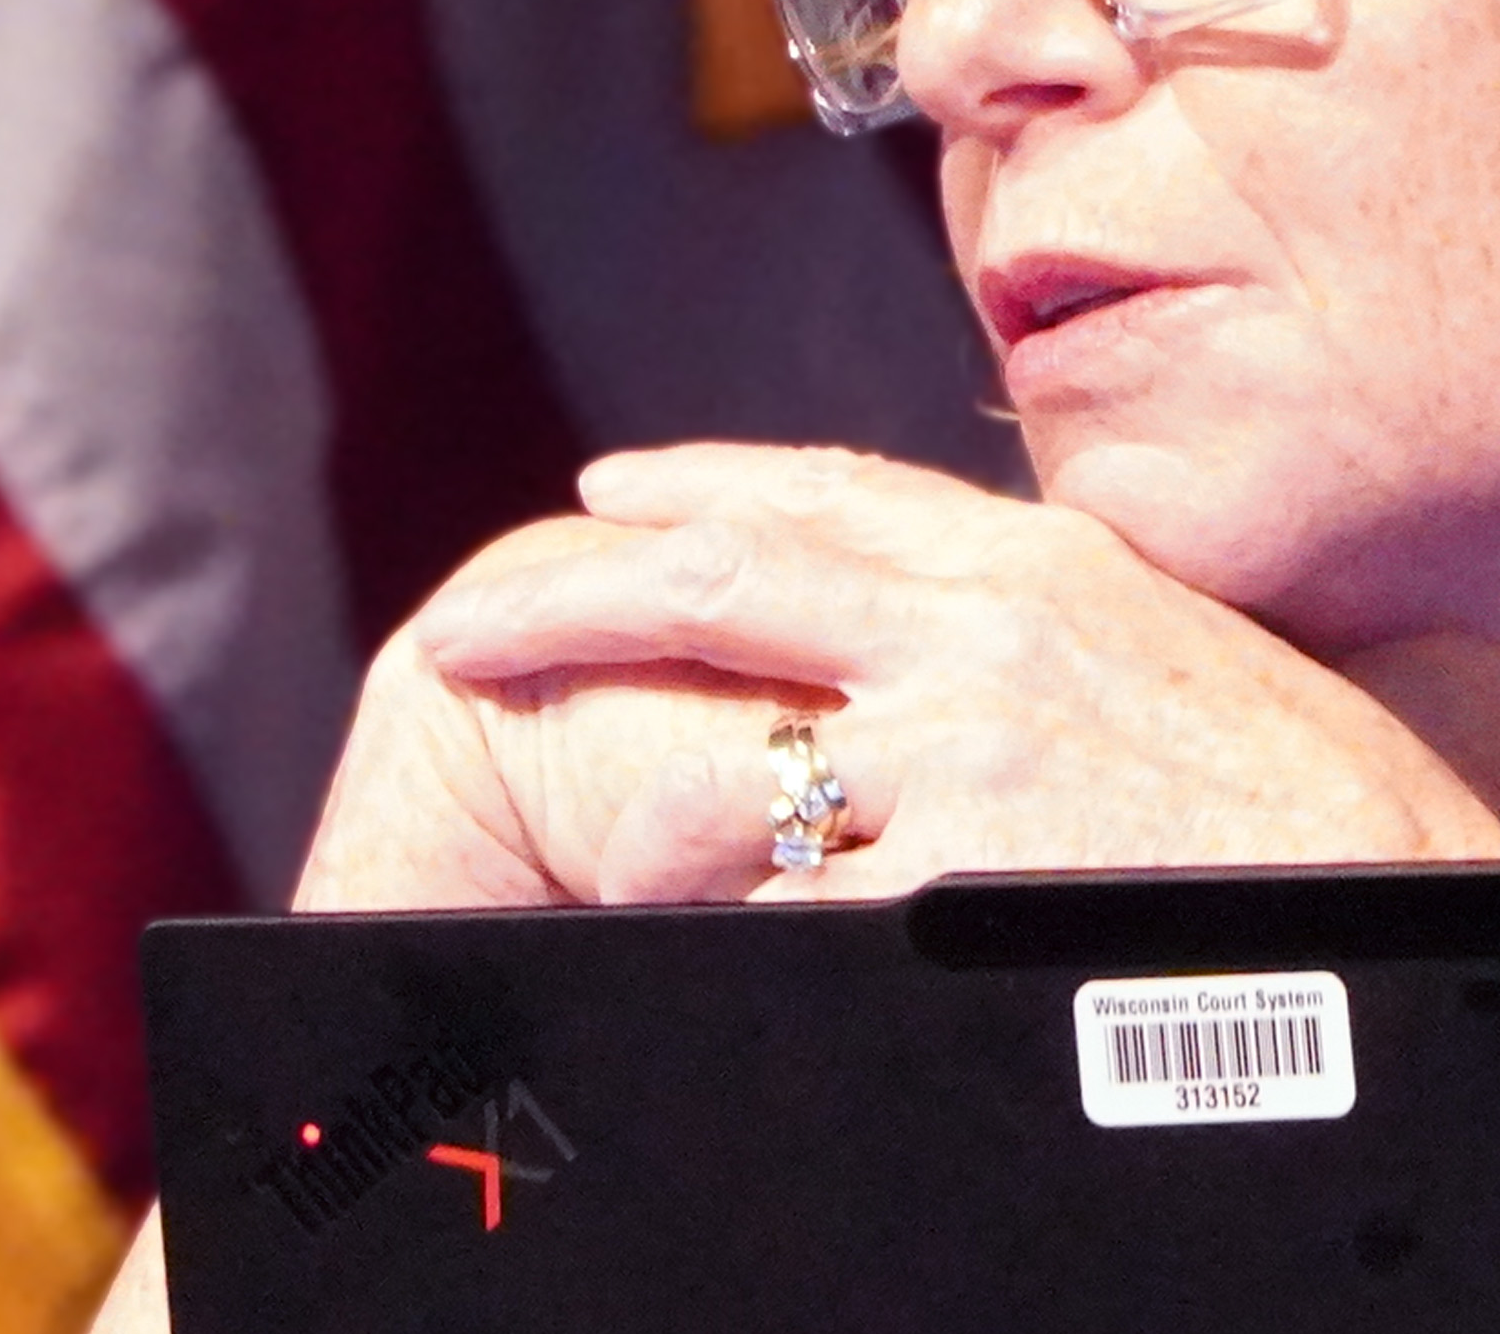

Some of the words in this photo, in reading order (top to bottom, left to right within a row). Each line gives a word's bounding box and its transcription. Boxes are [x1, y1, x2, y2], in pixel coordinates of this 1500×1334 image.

[1091, 992, 1190, 1015] Wisconsin
[1197, 990, 1248, 1013] Court
[1255, 988, 1325, 1013] System
[1175, 1083, 1262, 1111] 313152
